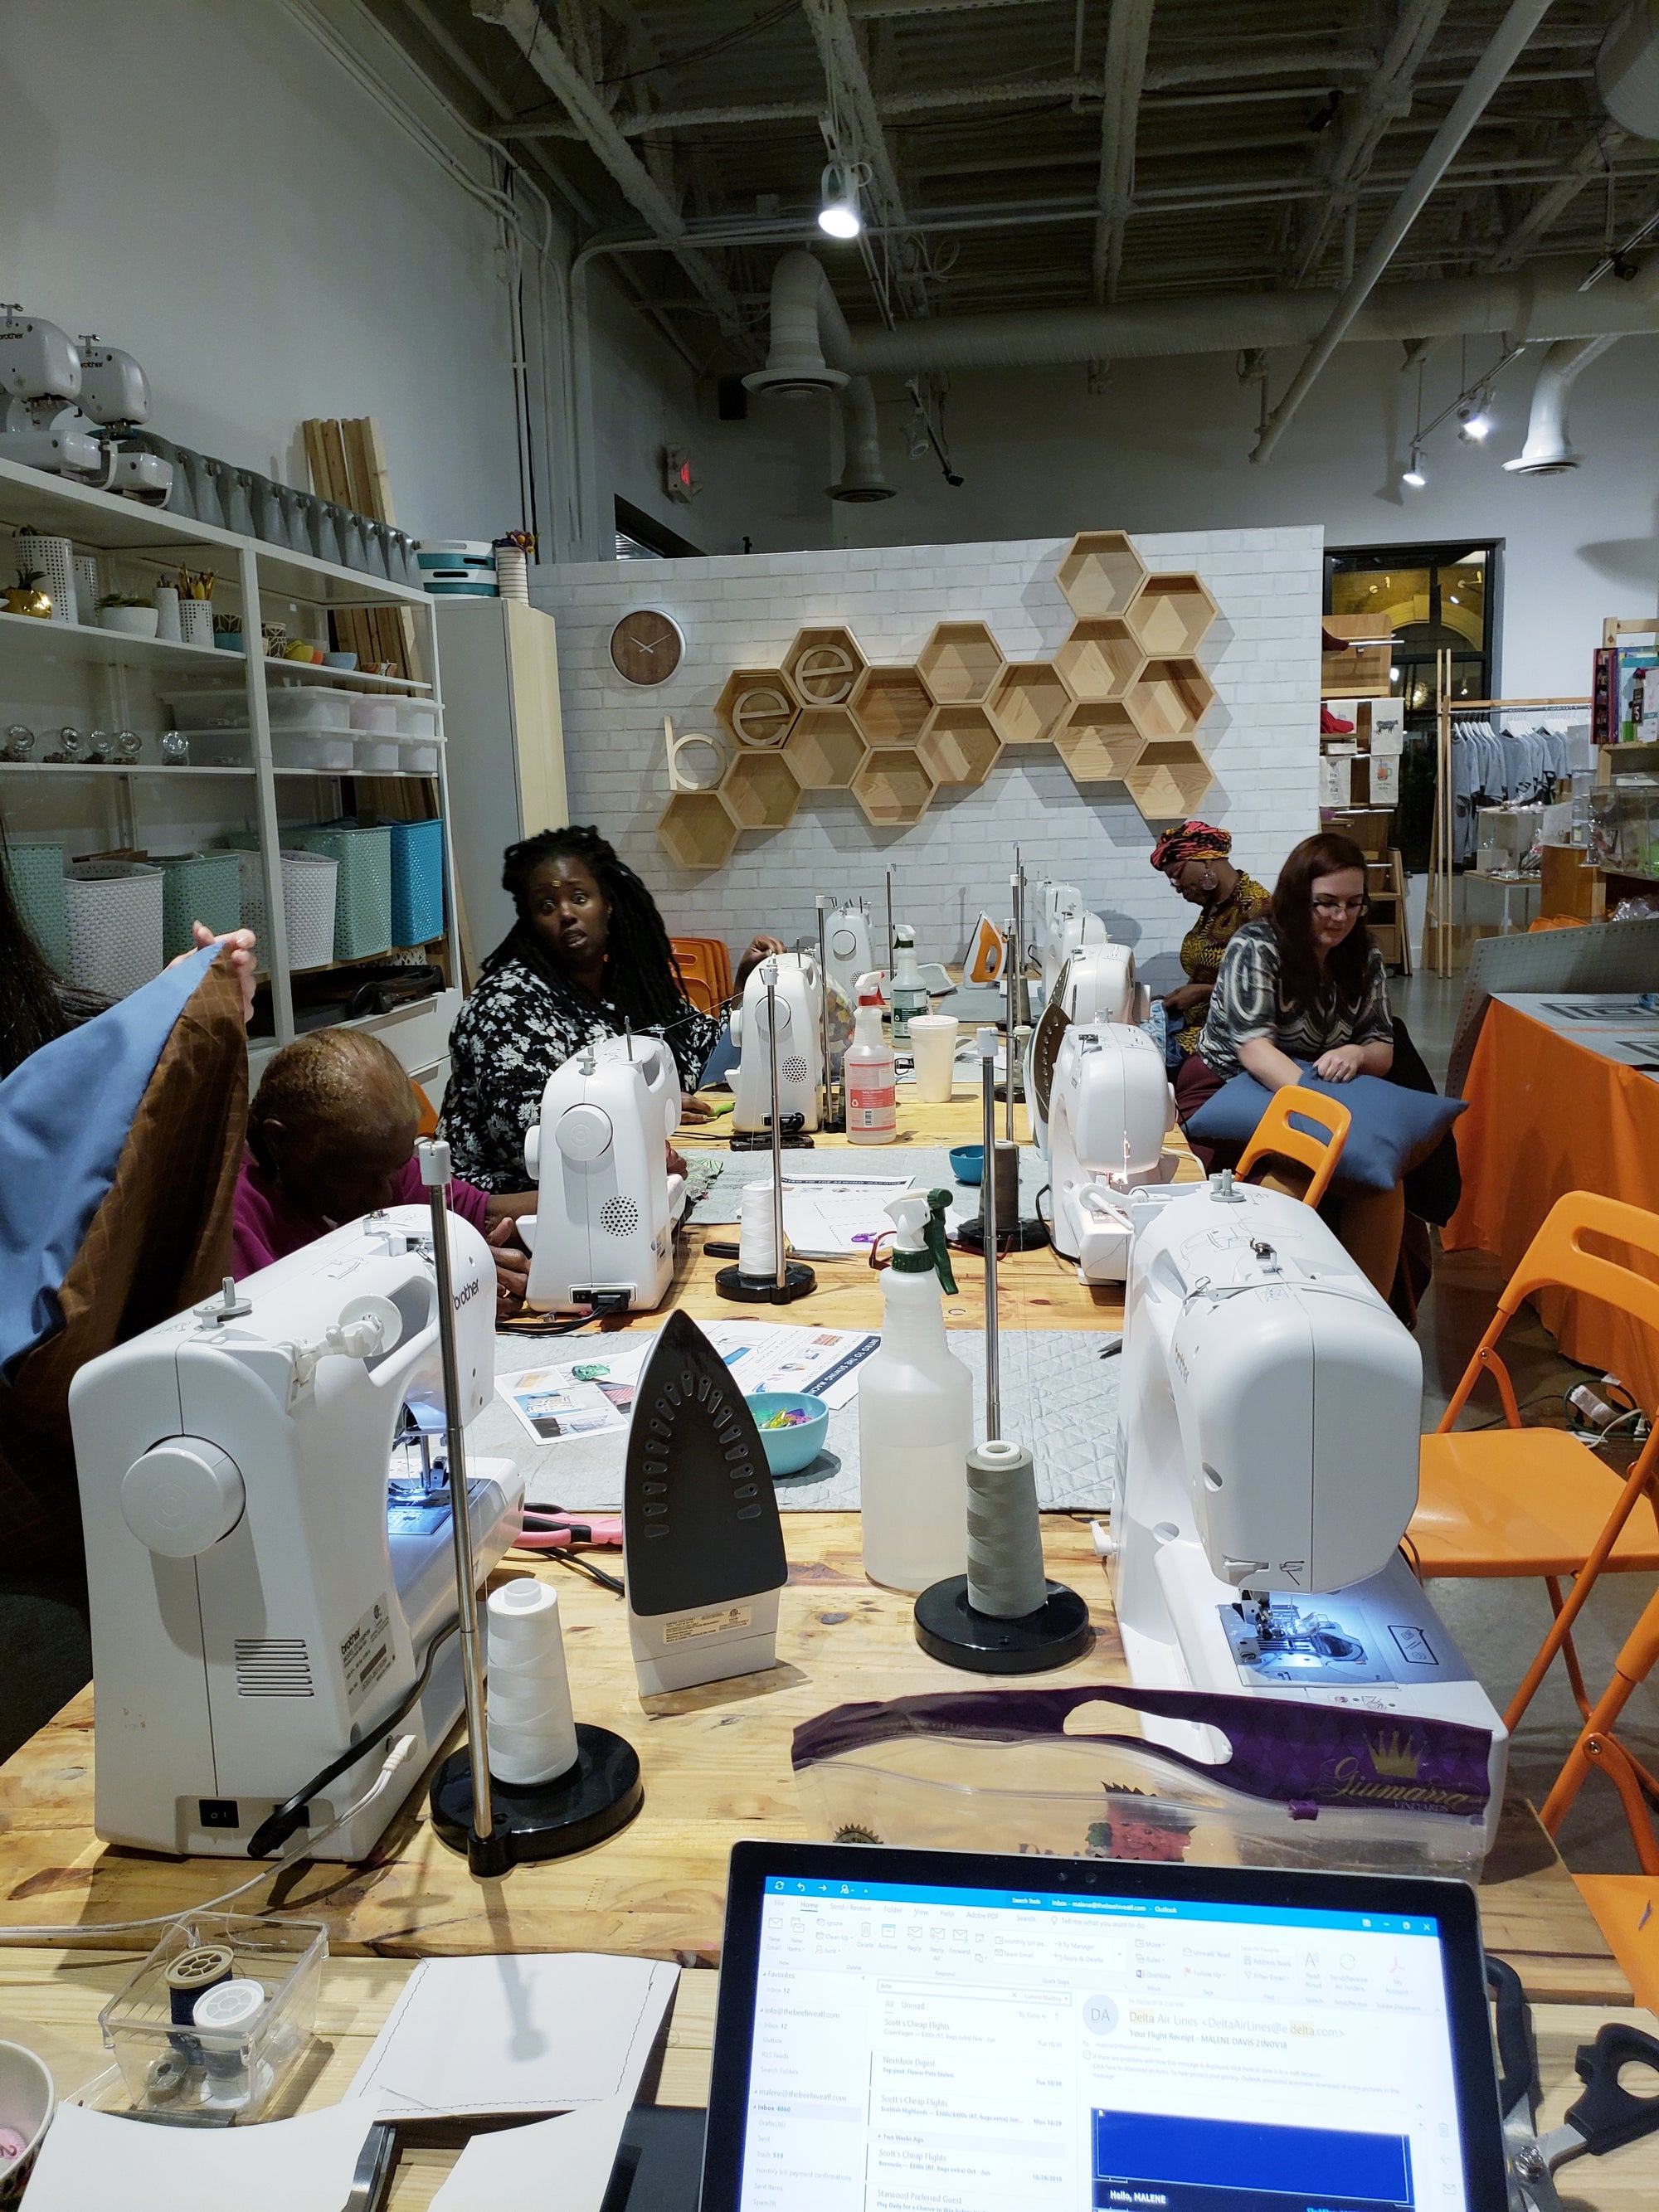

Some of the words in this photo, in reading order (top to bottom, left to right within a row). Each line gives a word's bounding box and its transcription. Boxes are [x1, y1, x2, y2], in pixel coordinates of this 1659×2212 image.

[452, 1278, 479, 1310] brother
[341, 1627, 360, 1655] brother
[1316, 1756, 1482, 1811] Giumarra
[966, 1911, 984, 1919] Adobe
[768, 1971, 795, 1979] Favorites
[902, 2001, 925, 2010] Unread
[765, 2007, 840, 2019] info@thebeehiveatl.com
[1090, 2007, 1111, 2023] DA
[1129, 2010, 1155, 2024] Delta
[1157, 2013, 1170, 2024] Air
[1174, 2015, 1198, 2027] Lines
[884, 2018, 906, 2028] Scott's
[907, 2020, 927, 2031] Cheap
[929, 2021, 950, 2030] Flights
[1130, 2029, 1146, 2039] Your
[1148, 2030, 1167, 2040] Flight
[1169, 2033, 1194, 2043] Receipt
[1201, 2035, 1230, 2044] MALENE
[1232, 2037, 1254, 2047] DAVIS
[883, 2056, 913, 2066] Nextdoor
[915, 2058, 936, 2068] Digest
[759, 2090, 847, 2102] malene@thebeehiveatl.com
[881, 2094, 902, 2103] Scott's
[904, 2097, 925, 2107] Cheap
[927, 2098, 947, 2107] Flights
[879, 2149, 901, 2158] Scott's
[902, 2151, 923, 2161] Cheap
[925, 2152, 946, 2162] Flights
[878, 2190, 908, 2200] Starwood
[911, 2192, 941, 2203] Preferred
[943, 2195, 962, 2205] Guest
[1110, 2190, 1132, 2202] Hello,
[1134, 2191, 1166, 2204] MALENE
